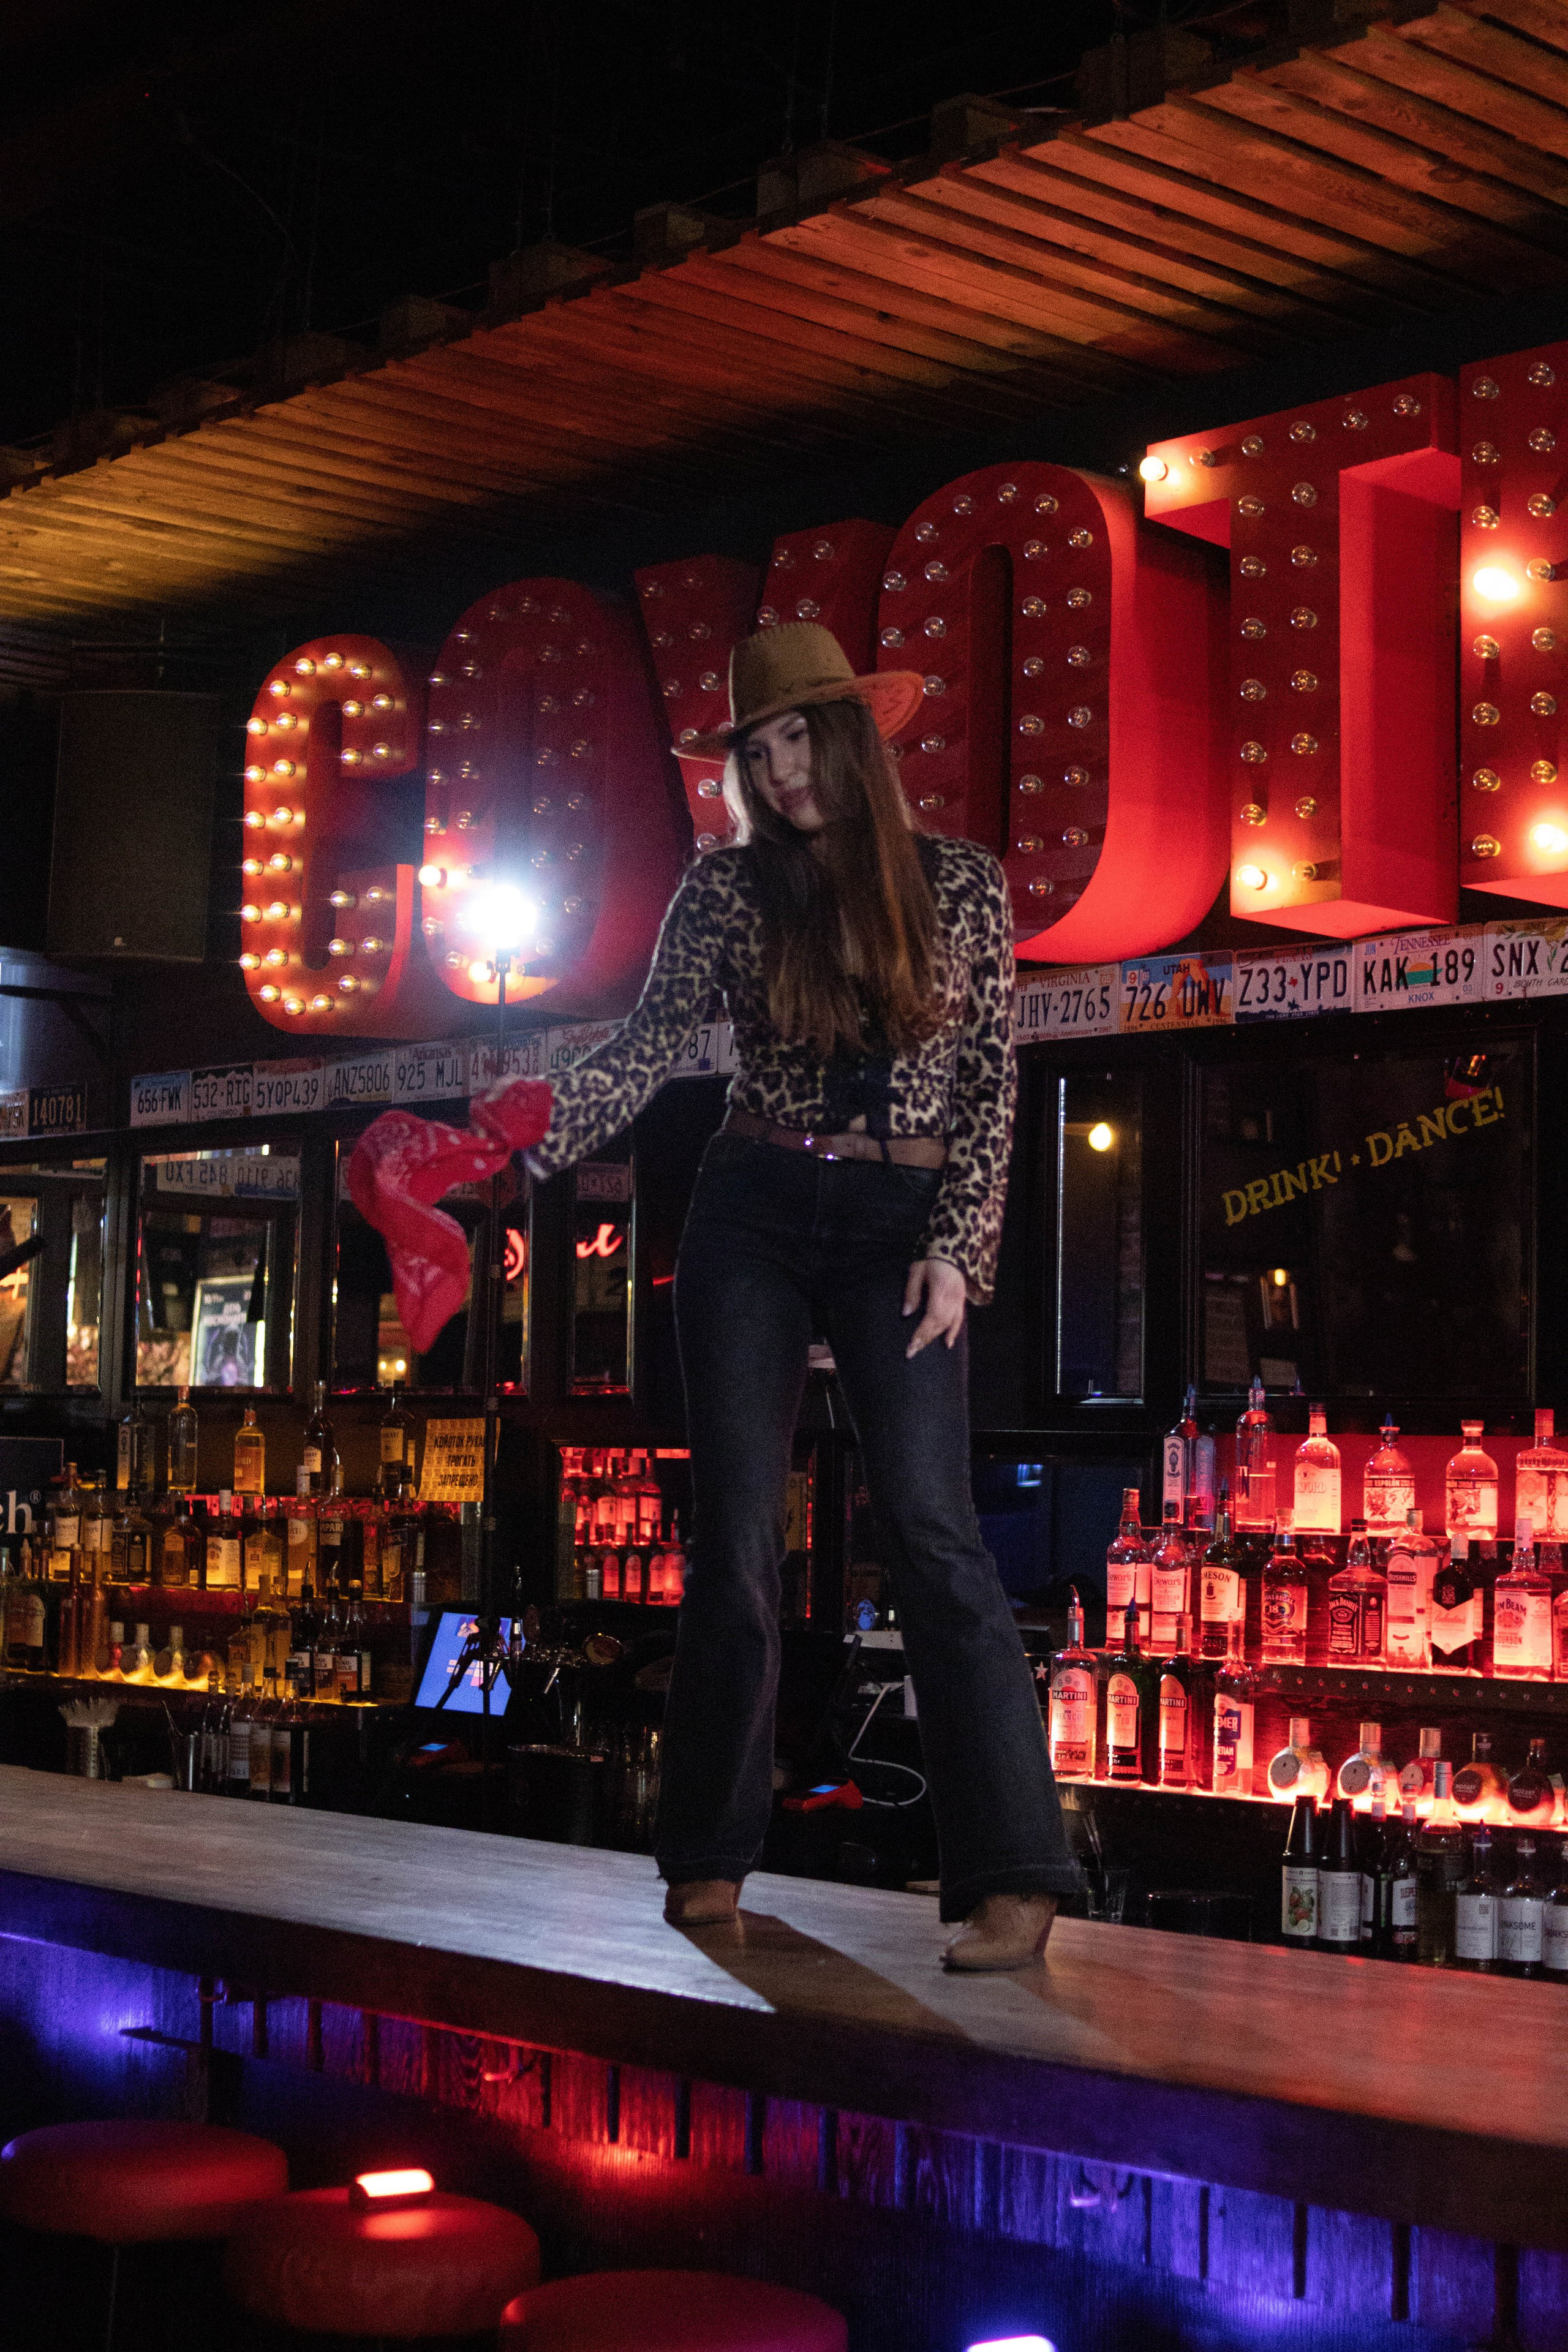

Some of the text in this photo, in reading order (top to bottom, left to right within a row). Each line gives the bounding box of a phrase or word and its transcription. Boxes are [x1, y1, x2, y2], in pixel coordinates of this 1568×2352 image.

[1393, 933, 1451, 955] TENNESSEE
[1491, 940, 1540, 978] SNX
[1129, 971, 1137, 984] 9
[1164, 963, 1191, 976] UTAH
[1363, 948, 1475, 995] KAK 189
[1041, 971, 1091, 989] VIRGINIA
[1238, 959, 1348, 1007] Z33 YPD
[1495, 982, 1504, 995] 9
[1513, 979, 1543, 989] SOUTH
[1126, 982, 1167, 1022] 726
[1409, 992, 1434, 1003] KNOX
[399, 1059, 464, 1091] 925 MJL
[32, 1093, 85, 1128] 140781
[1222, 1150, 1341, 1226] DRINK!
[1268, 1605, 1280, 1613] 18
[1506, 1598, 1527, 1618] BEAM
[1052, 1691, 1087, 1700] MARTINI
